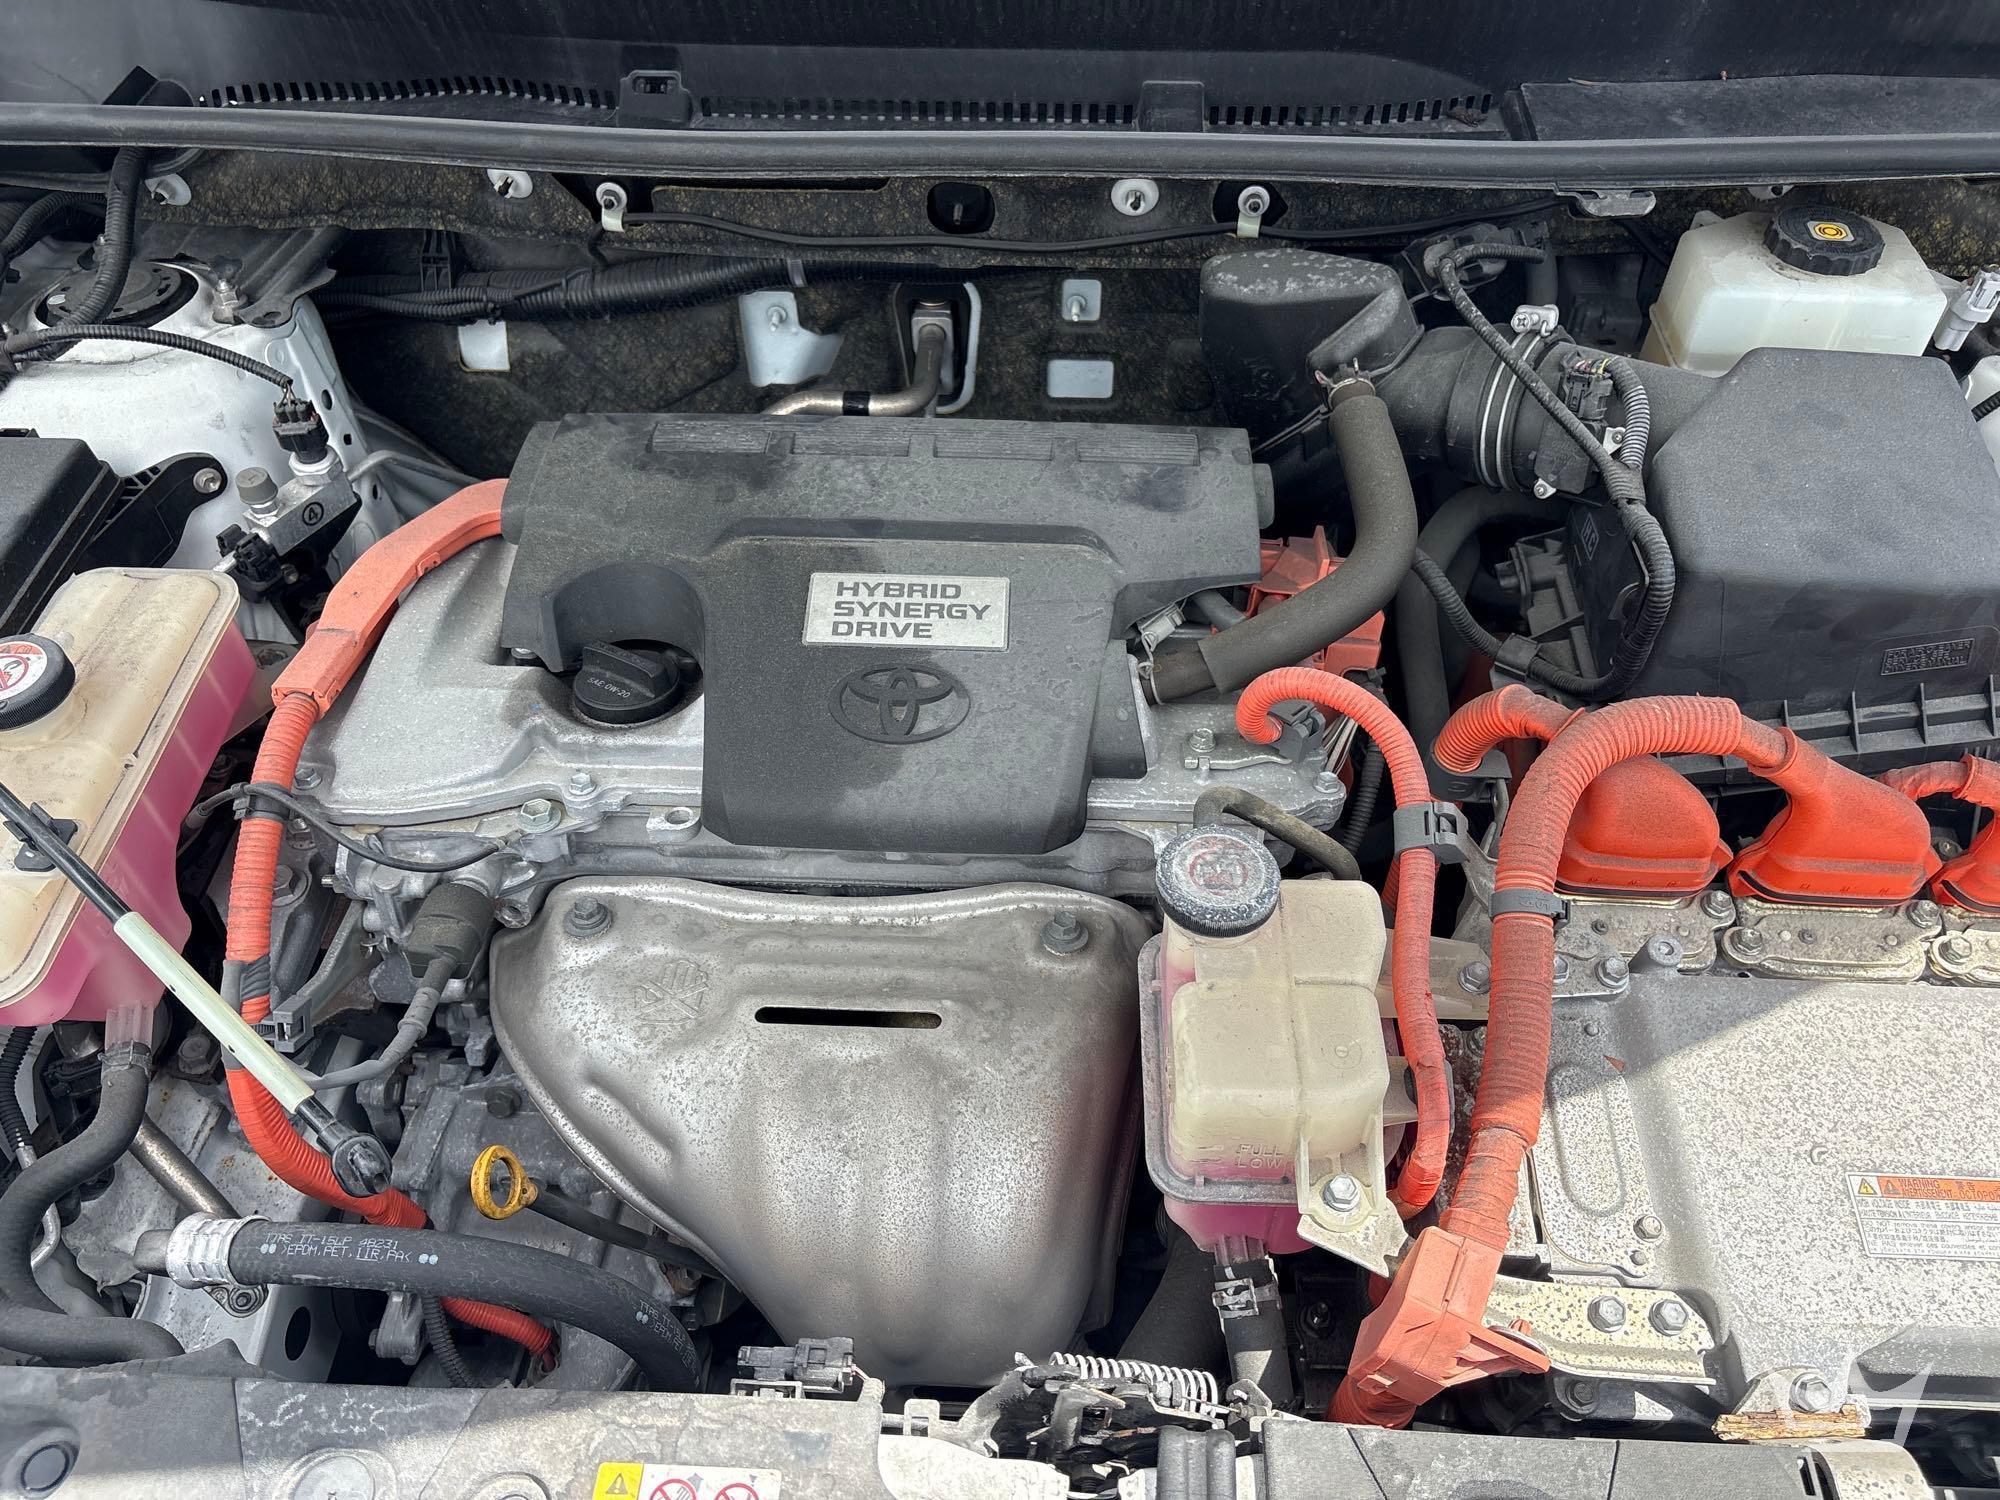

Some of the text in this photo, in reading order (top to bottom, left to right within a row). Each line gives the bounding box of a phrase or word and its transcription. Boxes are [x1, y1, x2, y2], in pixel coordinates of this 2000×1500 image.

[836, 581, 962, 599] HYBRID
[834, 601, 991, 620] SYNERGY
[831, 621, 933, 638] DRIVE
[587, 676, 631, 699] SAE 0W-20
[1236, 1144, 1283, 1157] FULL
[1235, 1158, 1282, 1168] LOW
[1898, 1178, 1940, 1190] WARNING
